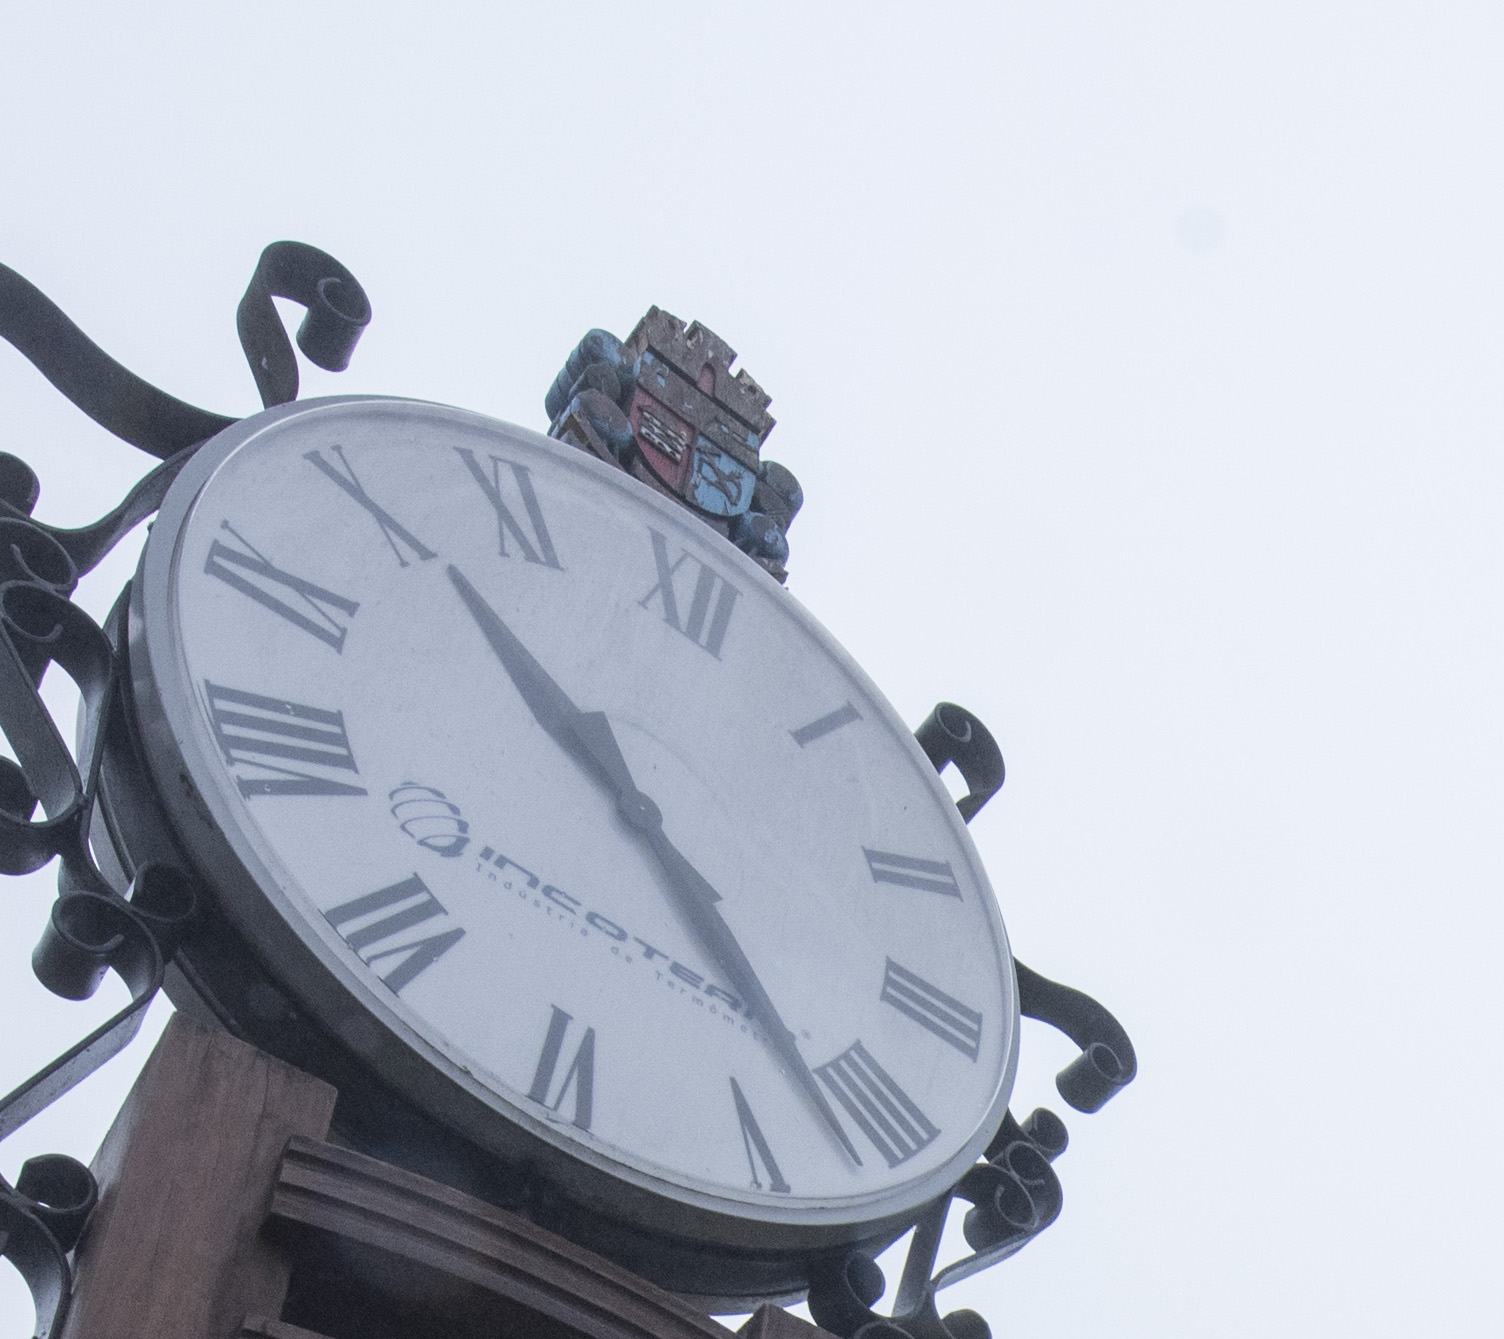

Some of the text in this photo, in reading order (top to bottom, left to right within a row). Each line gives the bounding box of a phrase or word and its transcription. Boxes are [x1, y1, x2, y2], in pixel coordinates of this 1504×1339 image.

[304, 444, 437, 568] X
[454, 446, 565, 571] XI
[204, 520, 360, 655] IX
[638, 526, 743, 661] XII
[204, 679, 368, 799] VIII
[788, 701, 863, 748] I
[321, 872, 466, 996] VII
[475, 862, 589, 937] Indústria
[610, 945, 633, 964] de
[861, 846, 963, 902] II
[527, 1003, 595, 1131] VI
[880, 955, 983, 1063] III
[729, 1077, 791, 1193] V
